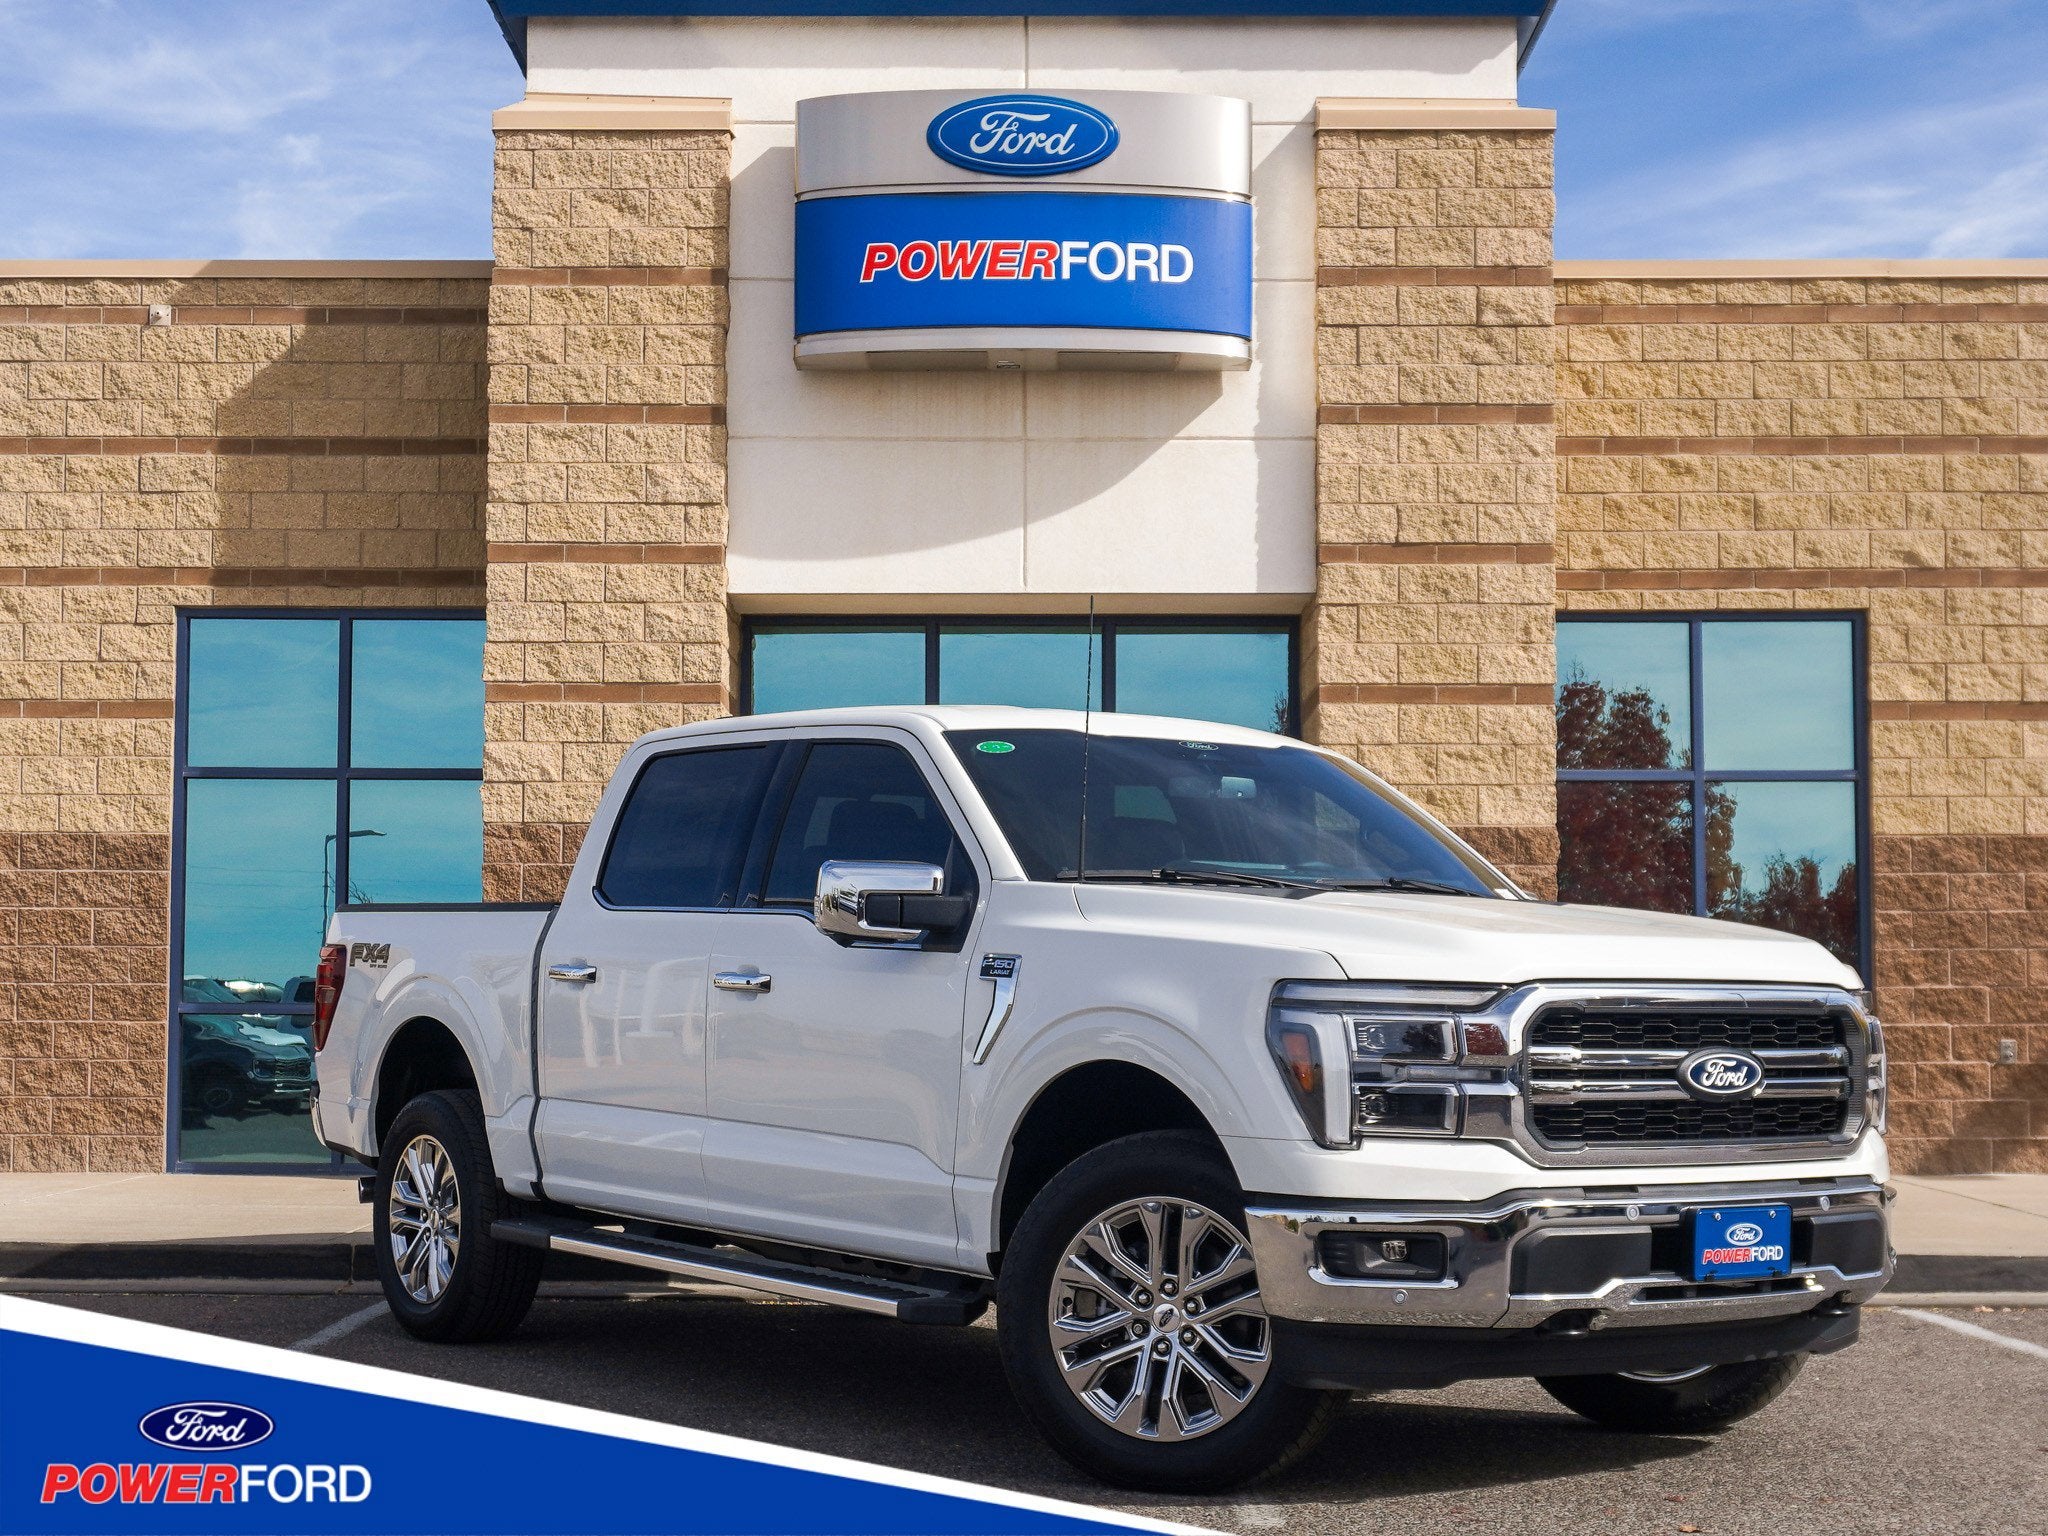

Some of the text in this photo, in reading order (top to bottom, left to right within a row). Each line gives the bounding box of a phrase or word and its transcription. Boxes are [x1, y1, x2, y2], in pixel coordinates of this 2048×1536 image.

[969, 110, 1078, 155] Ford
[859, 240, 1194, 283] POWERFORD
[349, 943, 391, 967] FX4
[1702, 1059, 1748, 1088] Ford
[1733, 1227, 1756, 1241] Ford
[1702, 1245, 1784, 1265] POWERFORD
